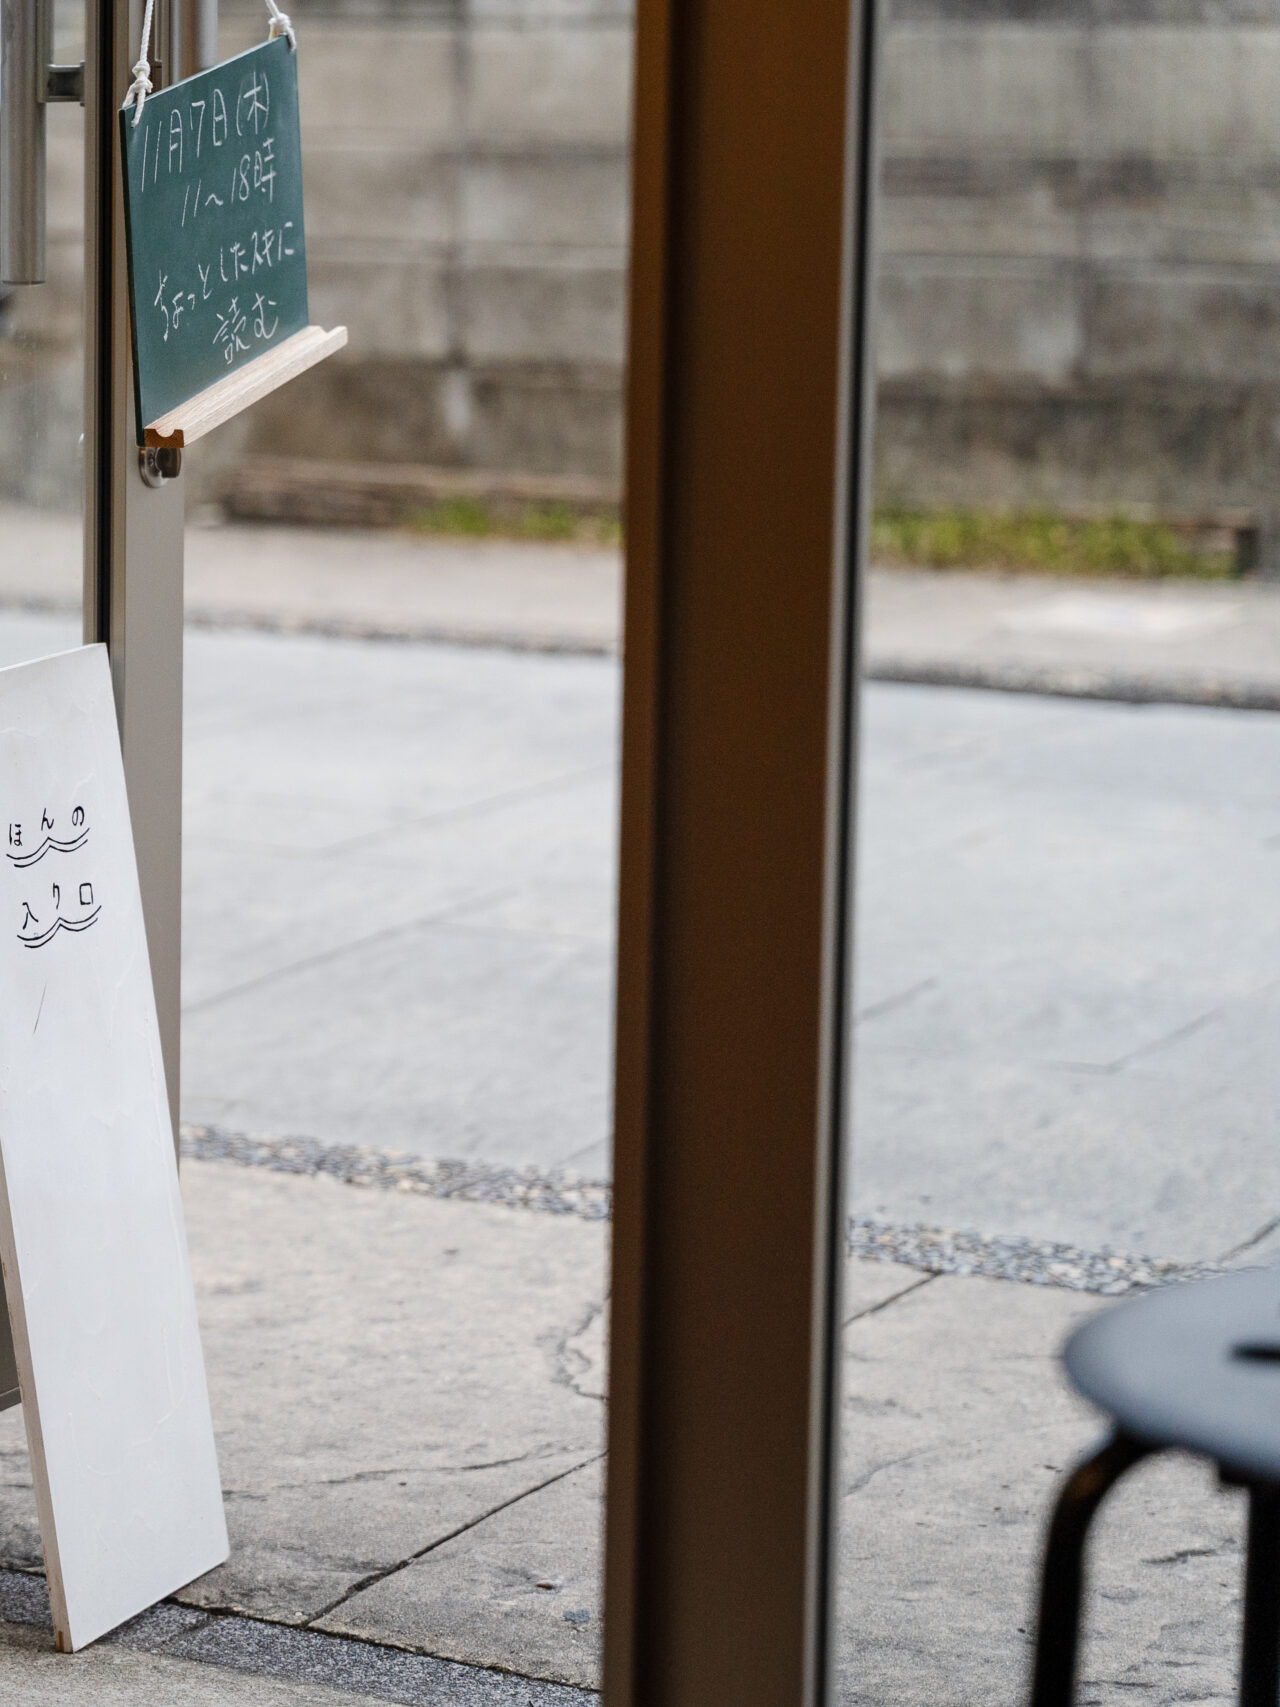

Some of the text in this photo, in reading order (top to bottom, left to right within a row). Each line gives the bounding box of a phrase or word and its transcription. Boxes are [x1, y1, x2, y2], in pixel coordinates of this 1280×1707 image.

[212, 292, 278, 366] 読む
[8, 805, 86, 847] ほんの
[22, 882, 95, 930] 入り口
